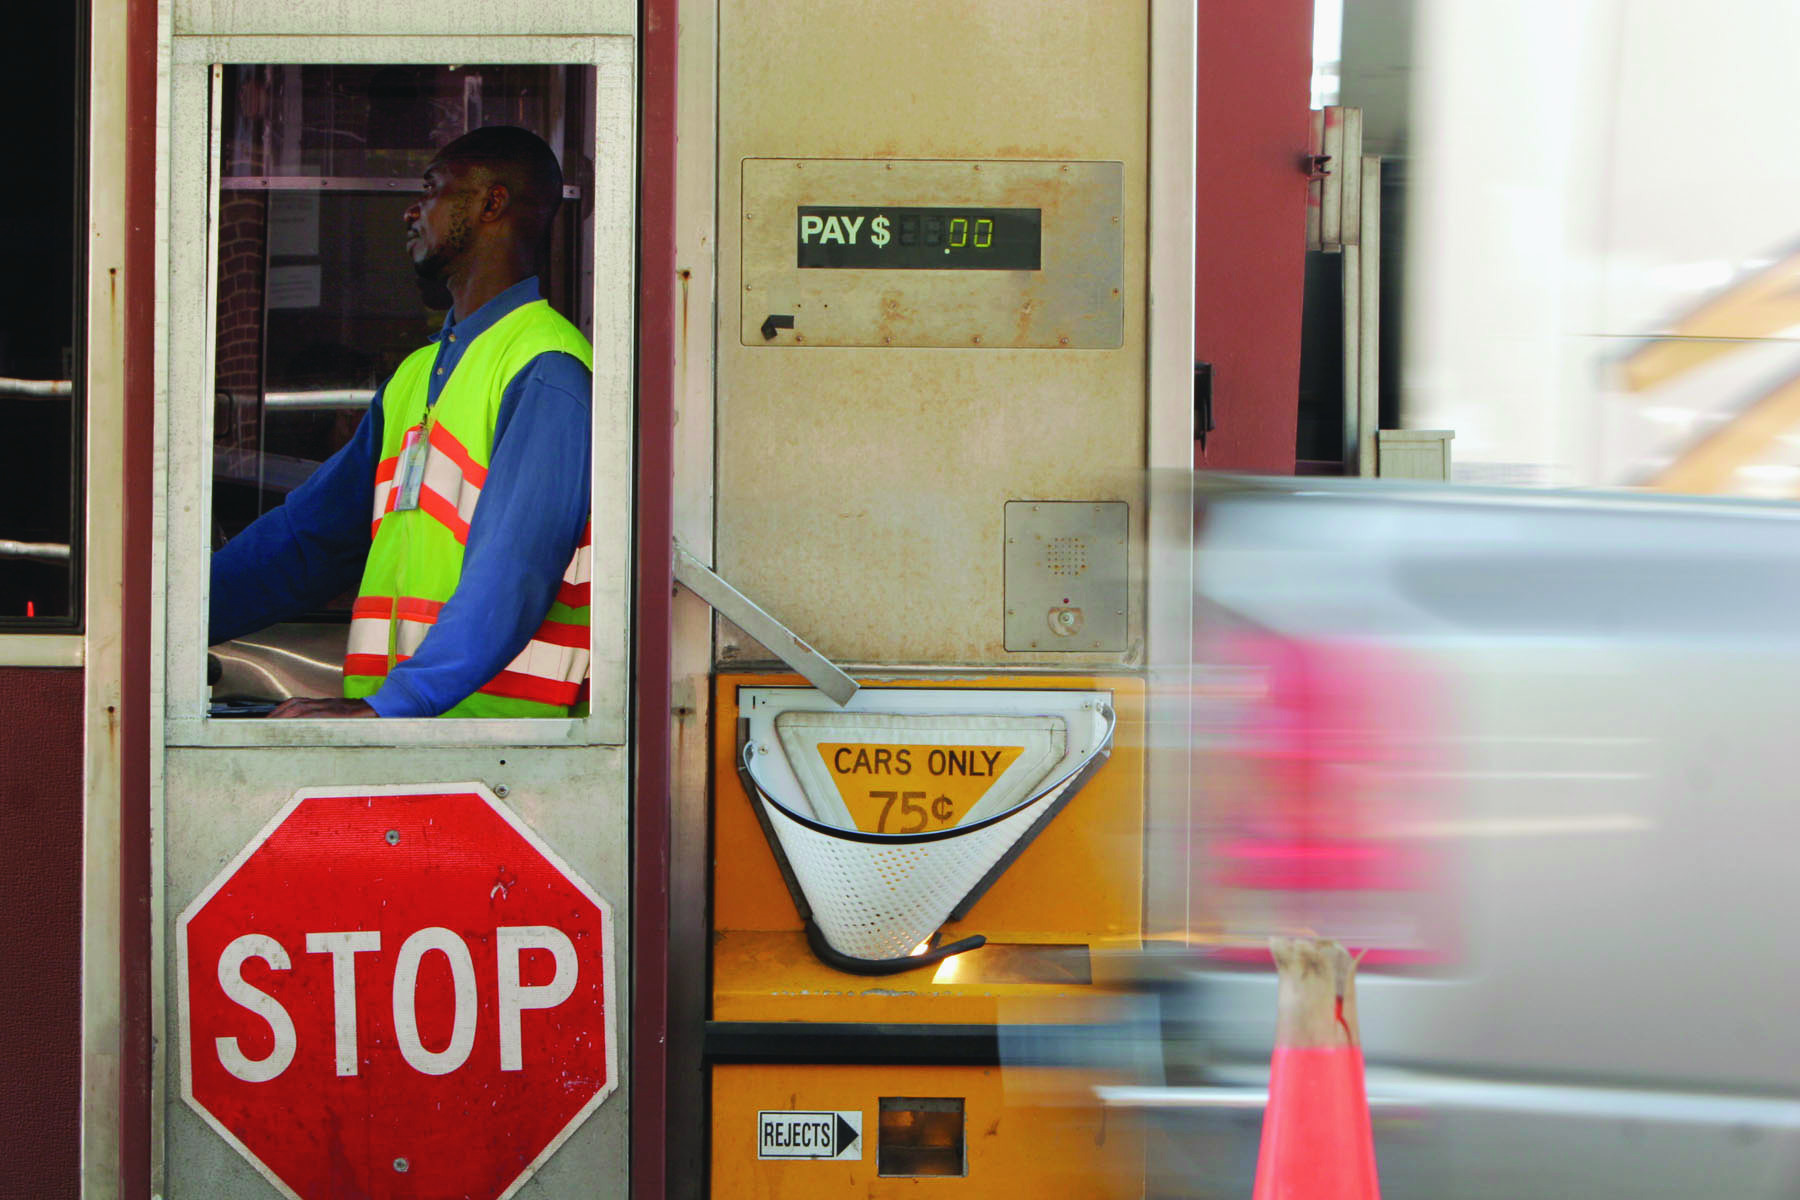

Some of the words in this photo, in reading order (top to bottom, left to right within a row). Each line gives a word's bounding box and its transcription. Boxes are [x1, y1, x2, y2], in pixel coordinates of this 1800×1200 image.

[802, 216, 865, 245] PAY
[871, 215, 891, 248] $
[835, 748, 912, 775] CARS
[928, 750, 1001, 776] ONLY
[869, 791, 953, 833] 75¢
[215, 926, 579, 1082] STOP
[764, 1123, 831, 1147] REJECTS
